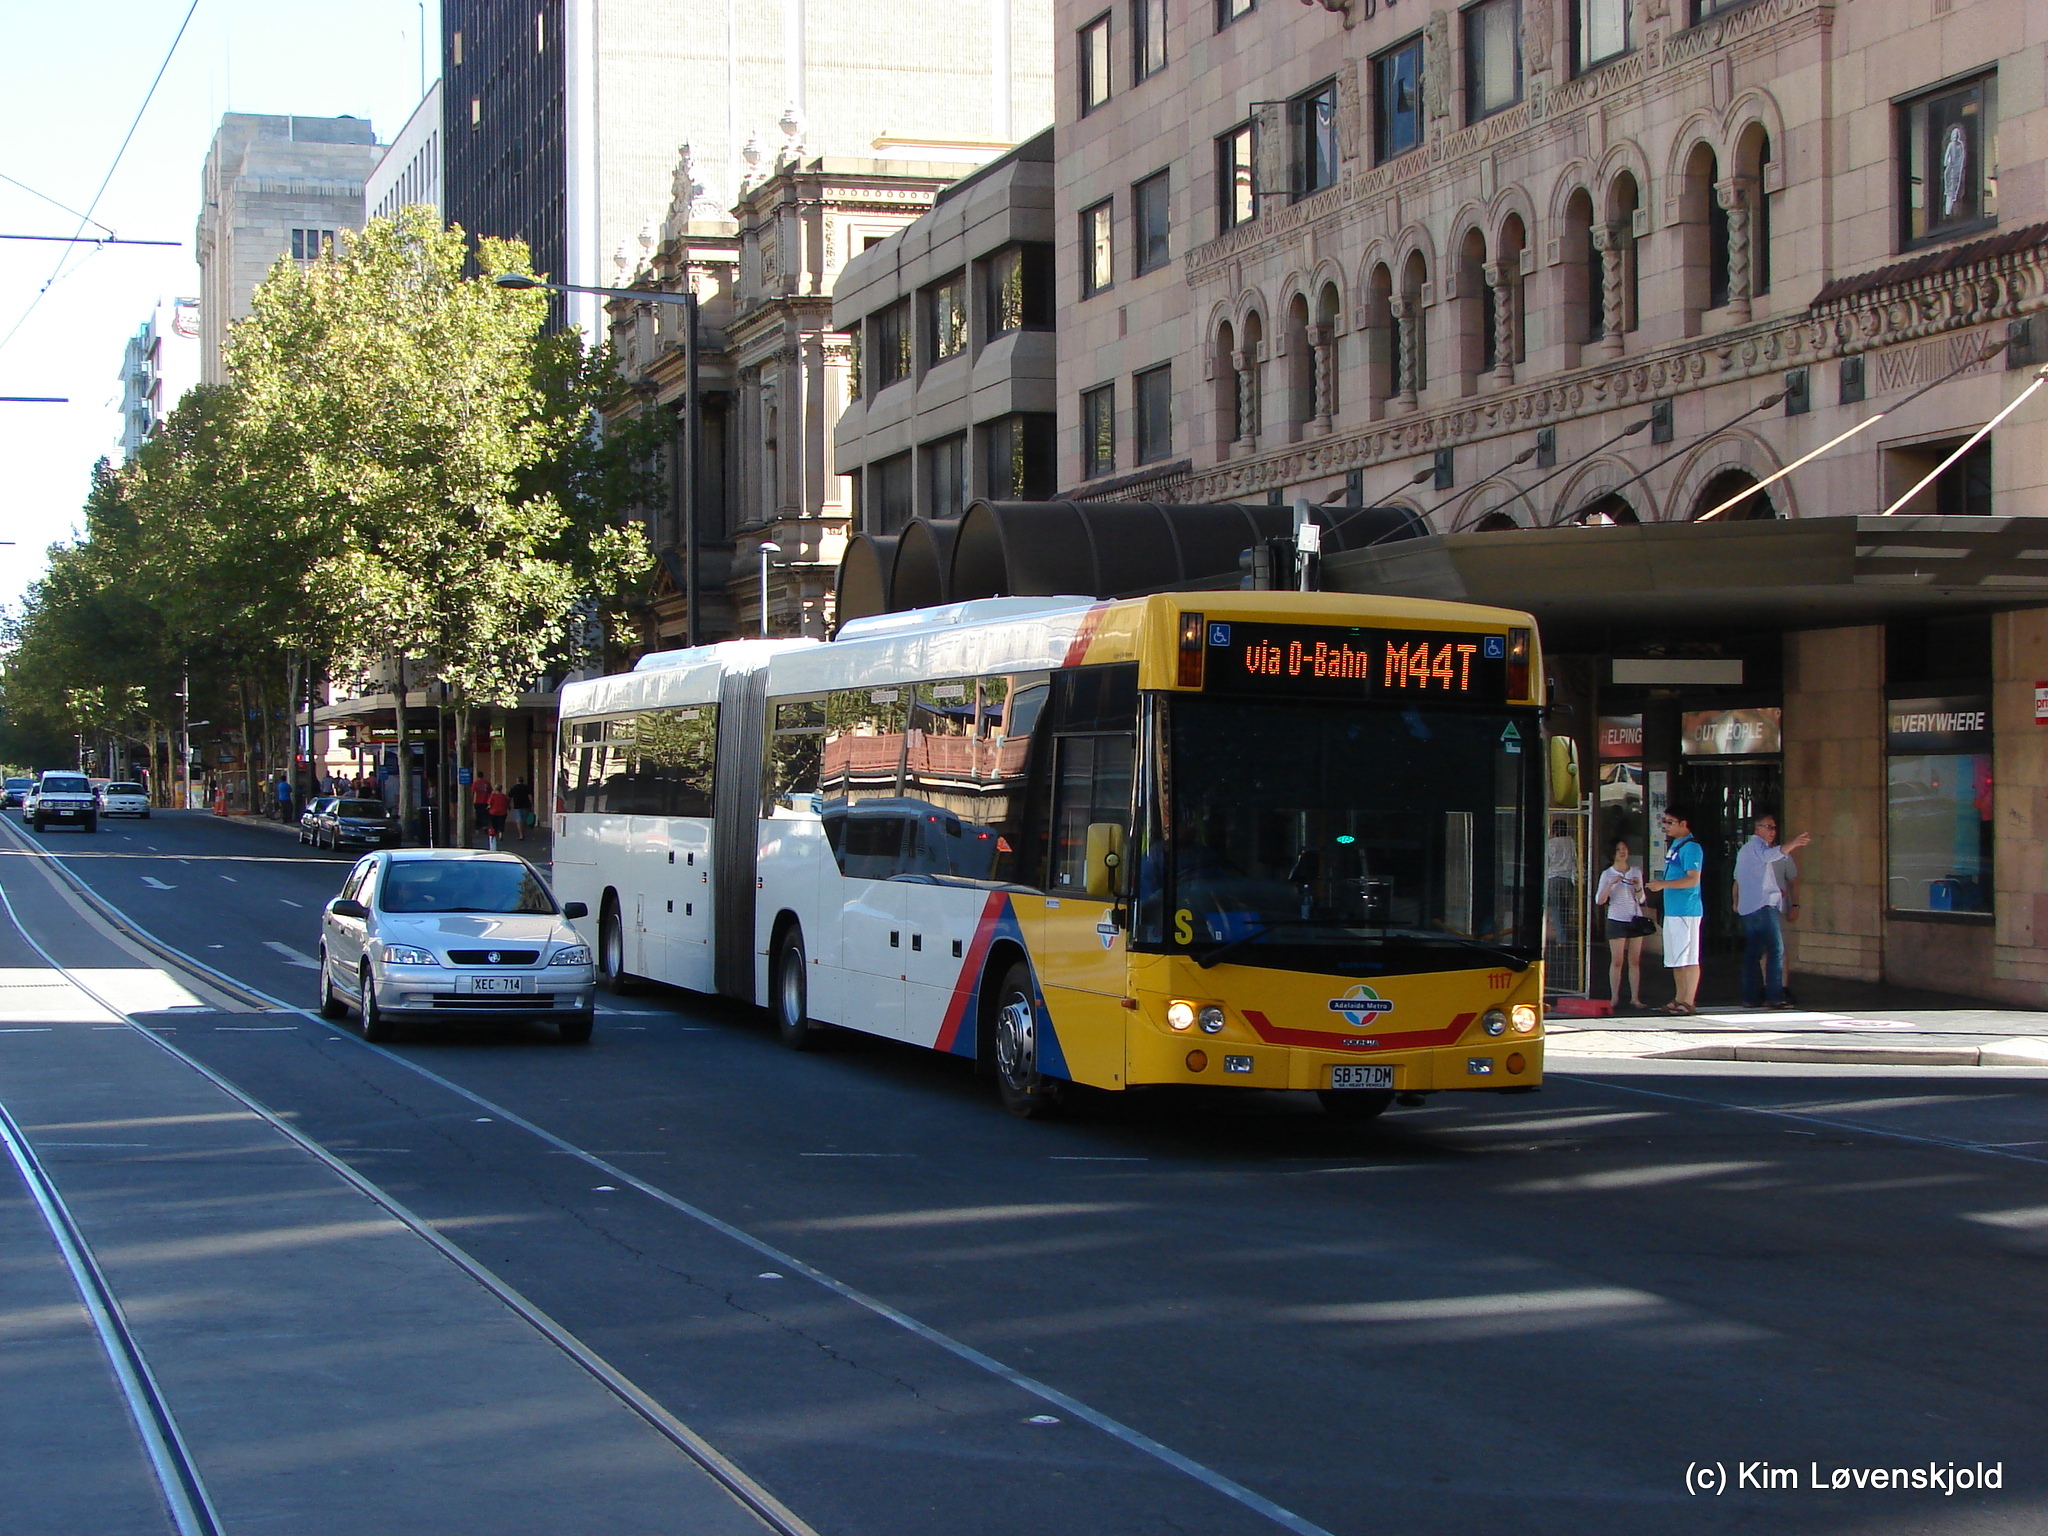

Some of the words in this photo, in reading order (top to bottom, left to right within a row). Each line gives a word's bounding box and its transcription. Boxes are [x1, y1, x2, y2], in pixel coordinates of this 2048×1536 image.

[1246, 639, 1281, 675] via
[1384, 640, 1478, 691] M44T
[1721, 721, 1764, 740] EOPLE
[1893, 711, 1985, 734] EVERYWHERE
[1601, 727, 1642, 745] HELPING
[1174, 908, 1193, 945] S
[475, 979, 494, 989] XEC
[503, 979, 520, 989] 714
[1488, 972, 1513, 989] 1117
